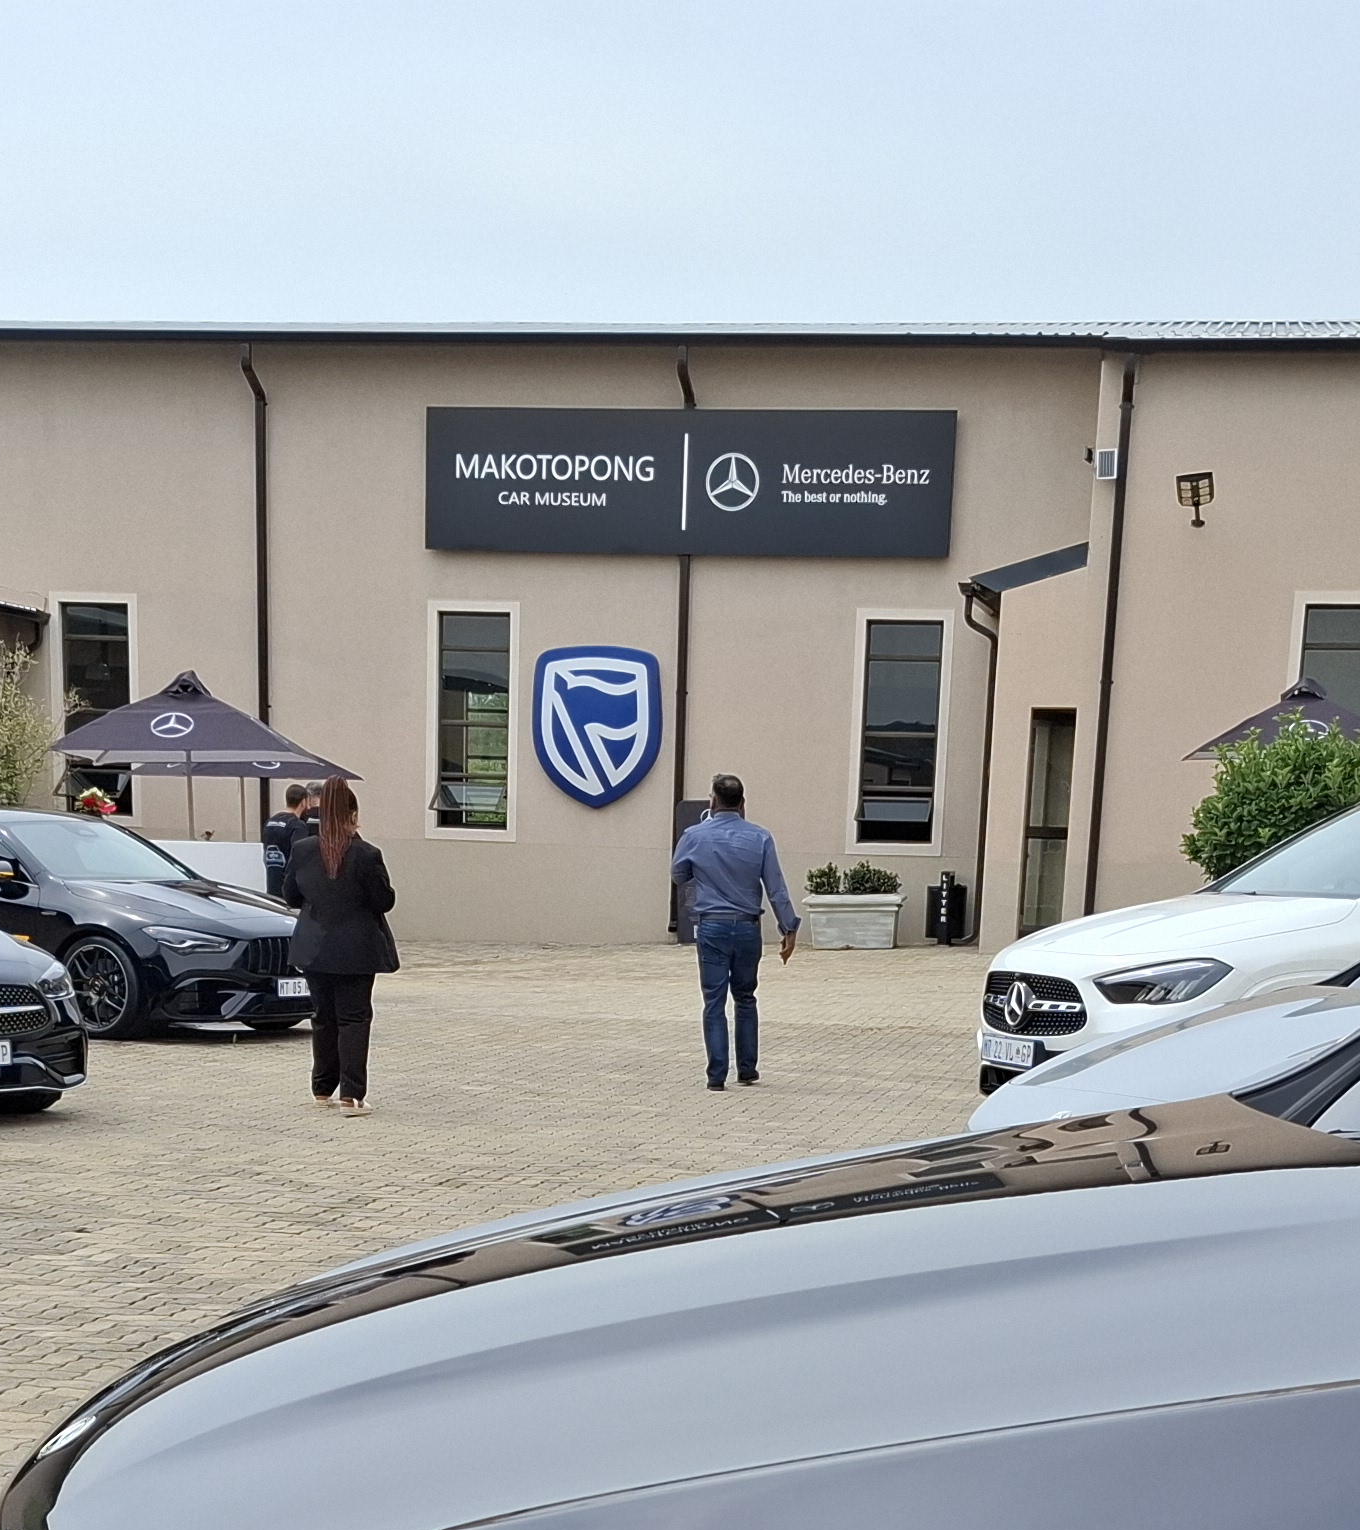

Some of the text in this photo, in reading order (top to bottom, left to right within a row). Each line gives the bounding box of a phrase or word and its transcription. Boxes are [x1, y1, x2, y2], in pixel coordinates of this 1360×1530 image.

[455, 453, 655, 482] MAKOTOPONG
[781, 463, 931, 485] Mercedes-Benz
[498, 491, 607, 507] CAR MUSEUM
[781, 490, 888, 506] The best or nothing.
[940, 874, 948, 923] LITTER
